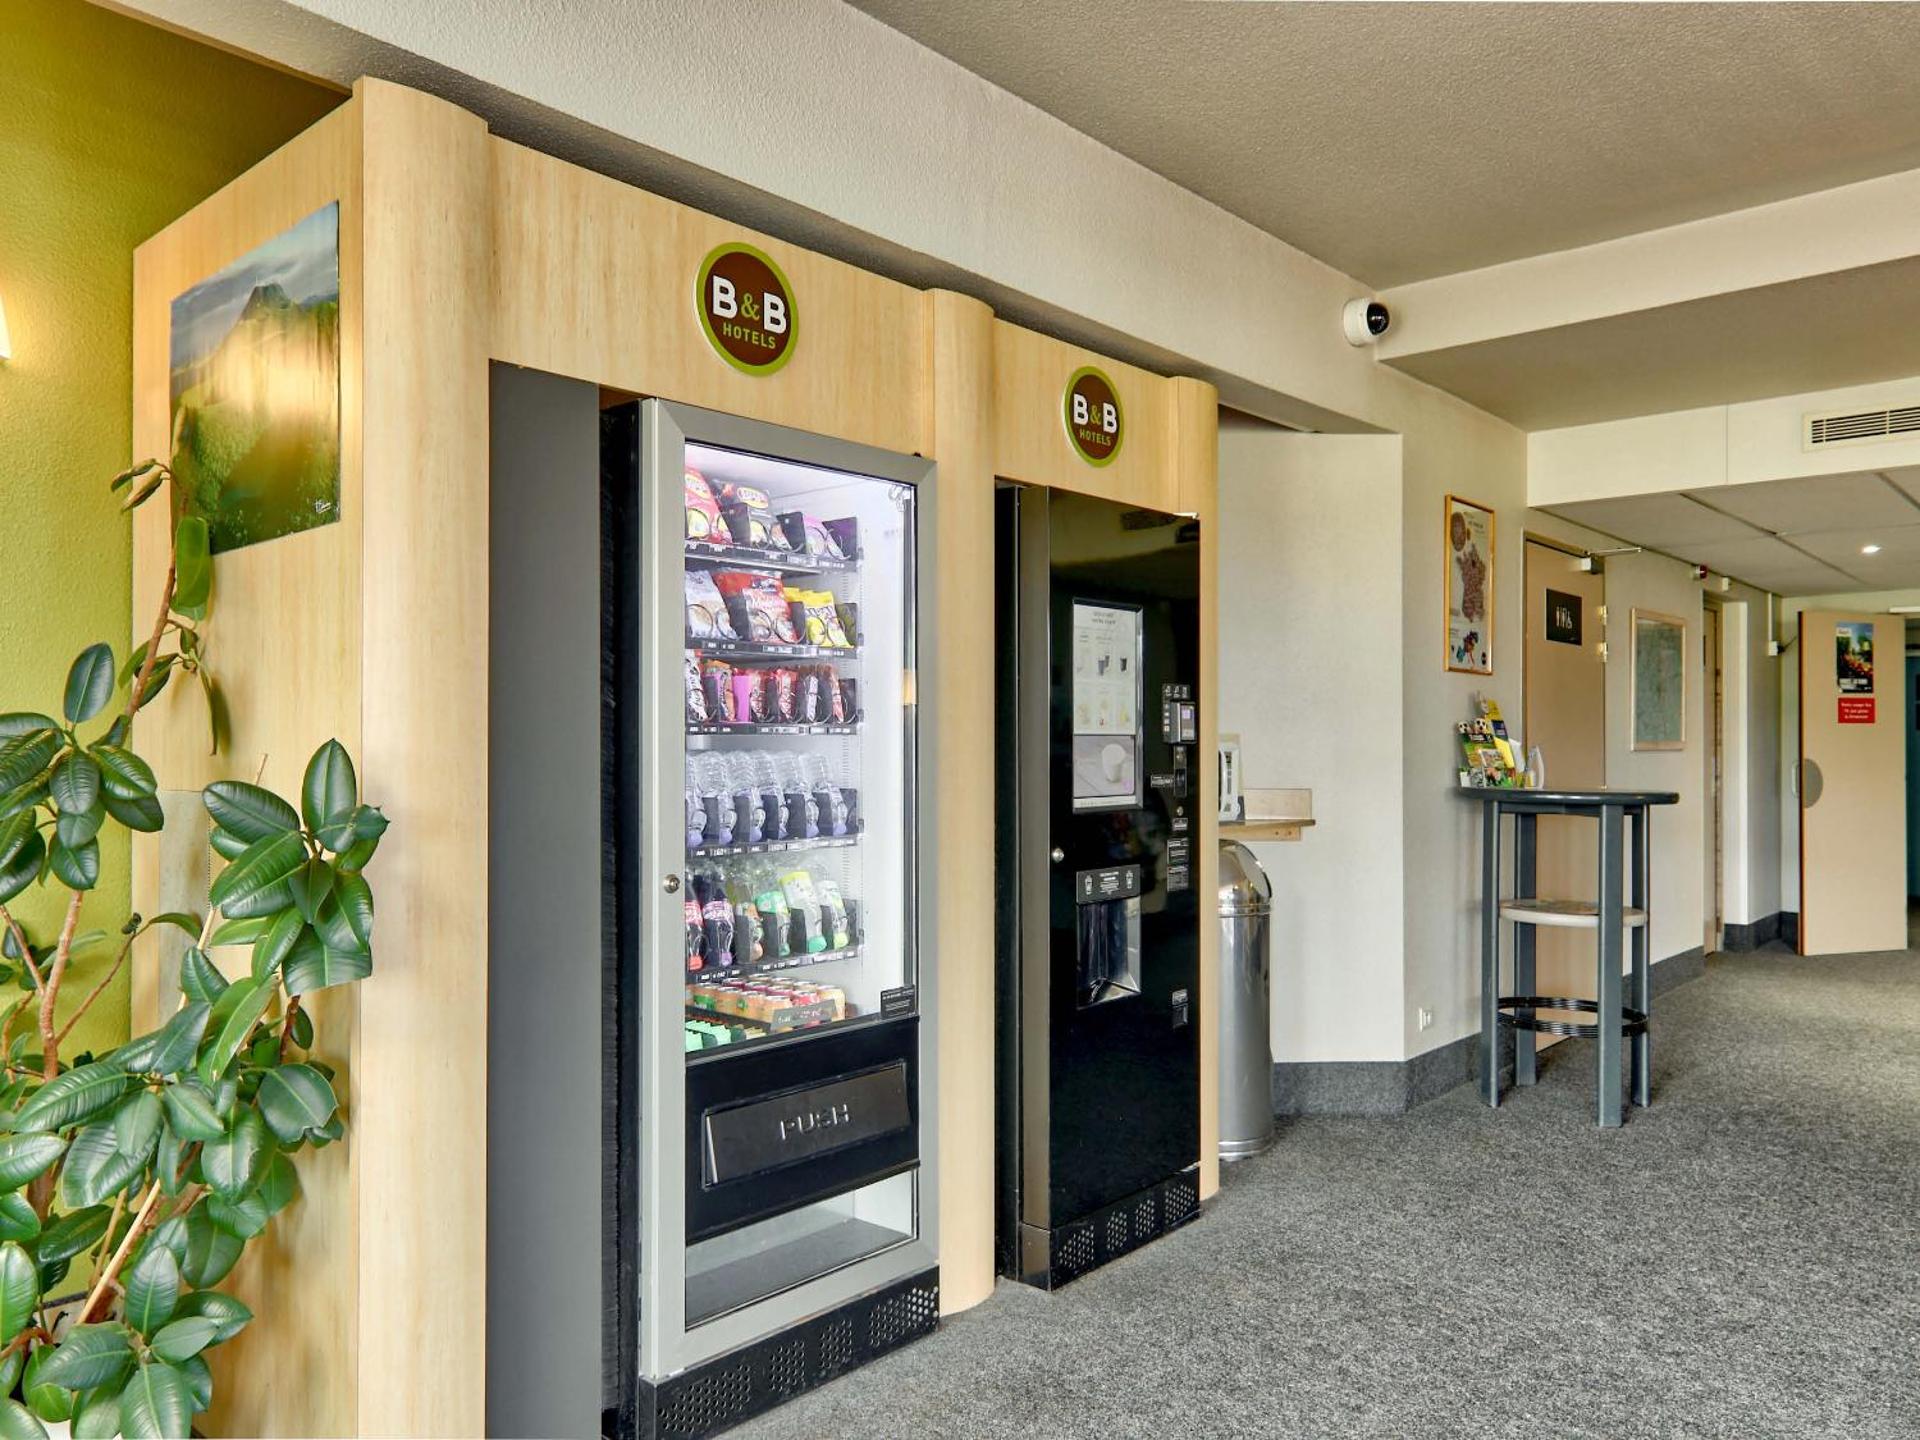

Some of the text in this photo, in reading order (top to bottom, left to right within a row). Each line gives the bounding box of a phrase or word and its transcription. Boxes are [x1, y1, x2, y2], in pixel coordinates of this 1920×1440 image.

[713, 275, 787, 334] B&B
[722, 321, 777, 349] HOTELS
[1074, 393, 1118, 433] B&B
[1079, 428, 1112, 446] HOTELS
[780, 1103, 850, 1141] PUSH
